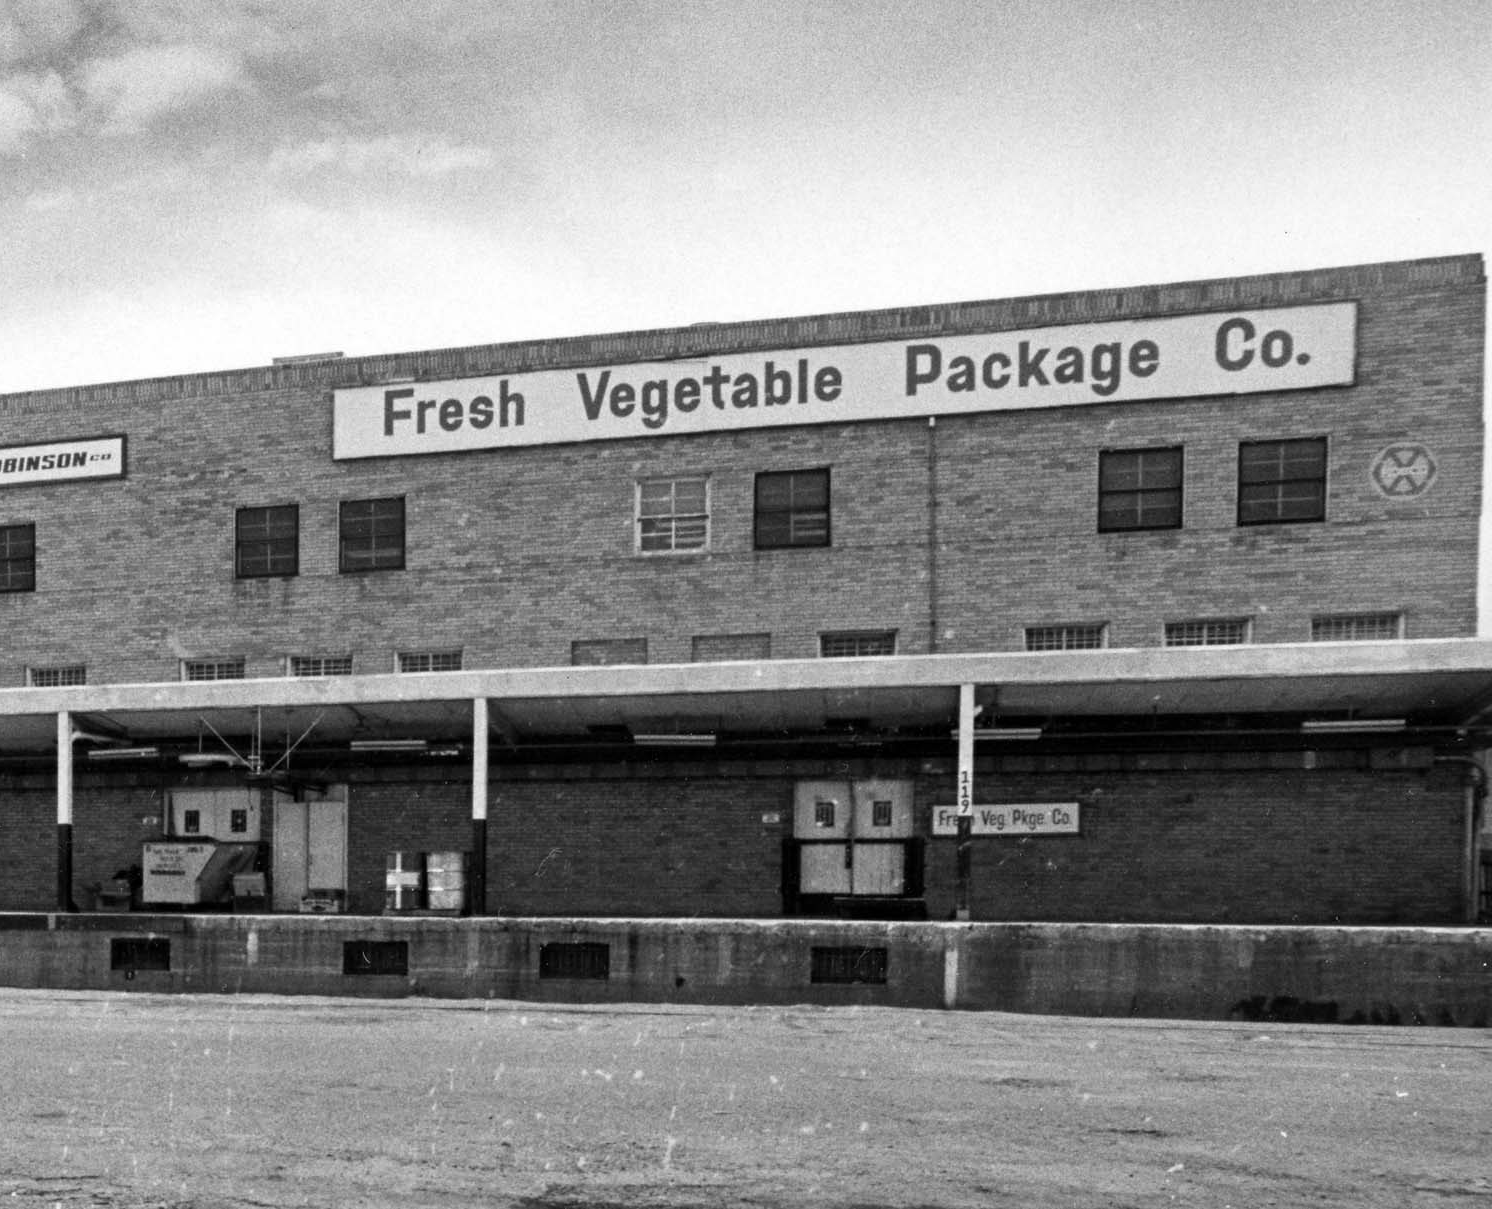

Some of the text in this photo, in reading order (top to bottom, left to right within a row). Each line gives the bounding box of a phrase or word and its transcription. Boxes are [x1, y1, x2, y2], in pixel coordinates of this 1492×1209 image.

[384, 317, 1312, 436] Fresh Vegetable Package Co.
[961, 771, 970, 814] 119
